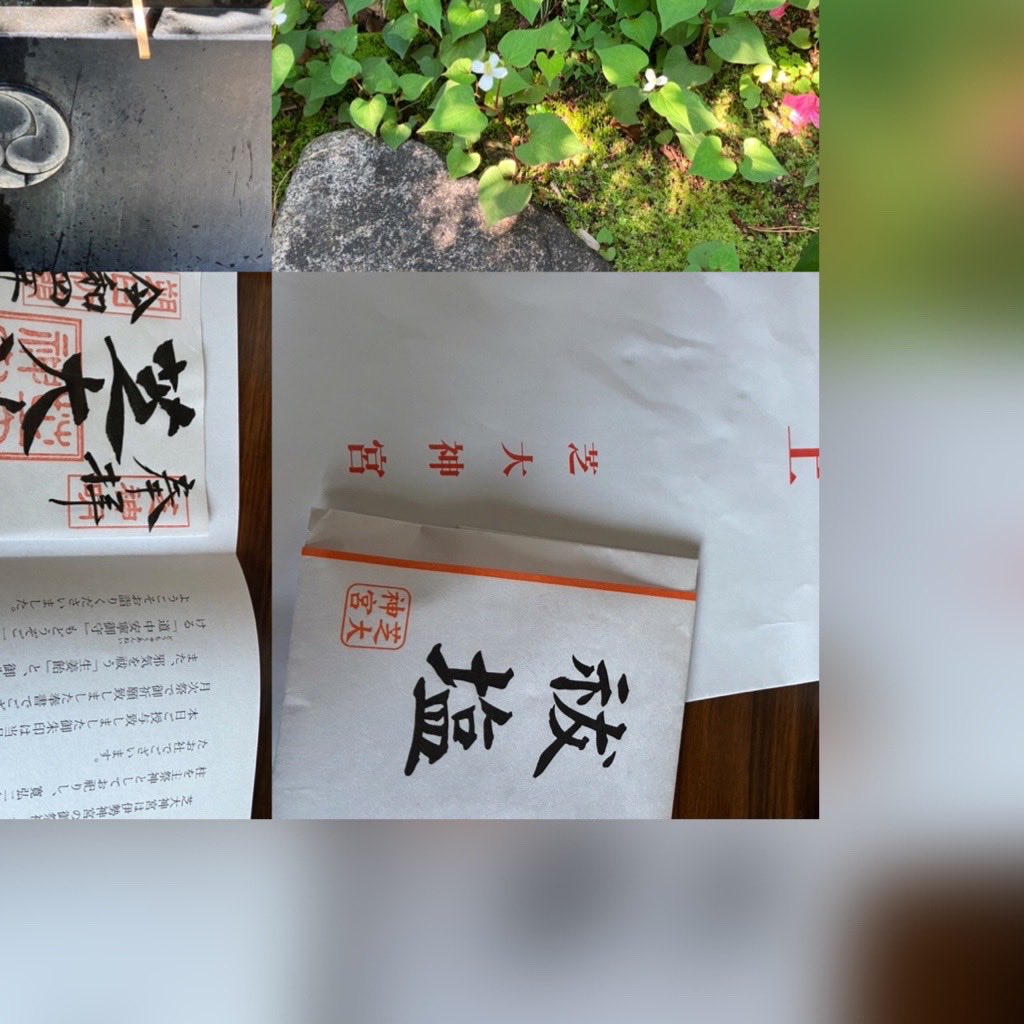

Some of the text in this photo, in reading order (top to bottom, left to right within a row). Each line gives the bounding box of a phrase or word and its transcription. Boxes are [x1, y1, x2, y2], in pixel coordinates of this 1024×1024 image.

[348, 439, 600, 479] 芝大神宮
[349, 588, 406, 617] 神宮
[346, 619, 401, 645] 芝大
[404, 642, 630, 778] 祓塩
[93, 739, 209, 763] たお社でございます。
